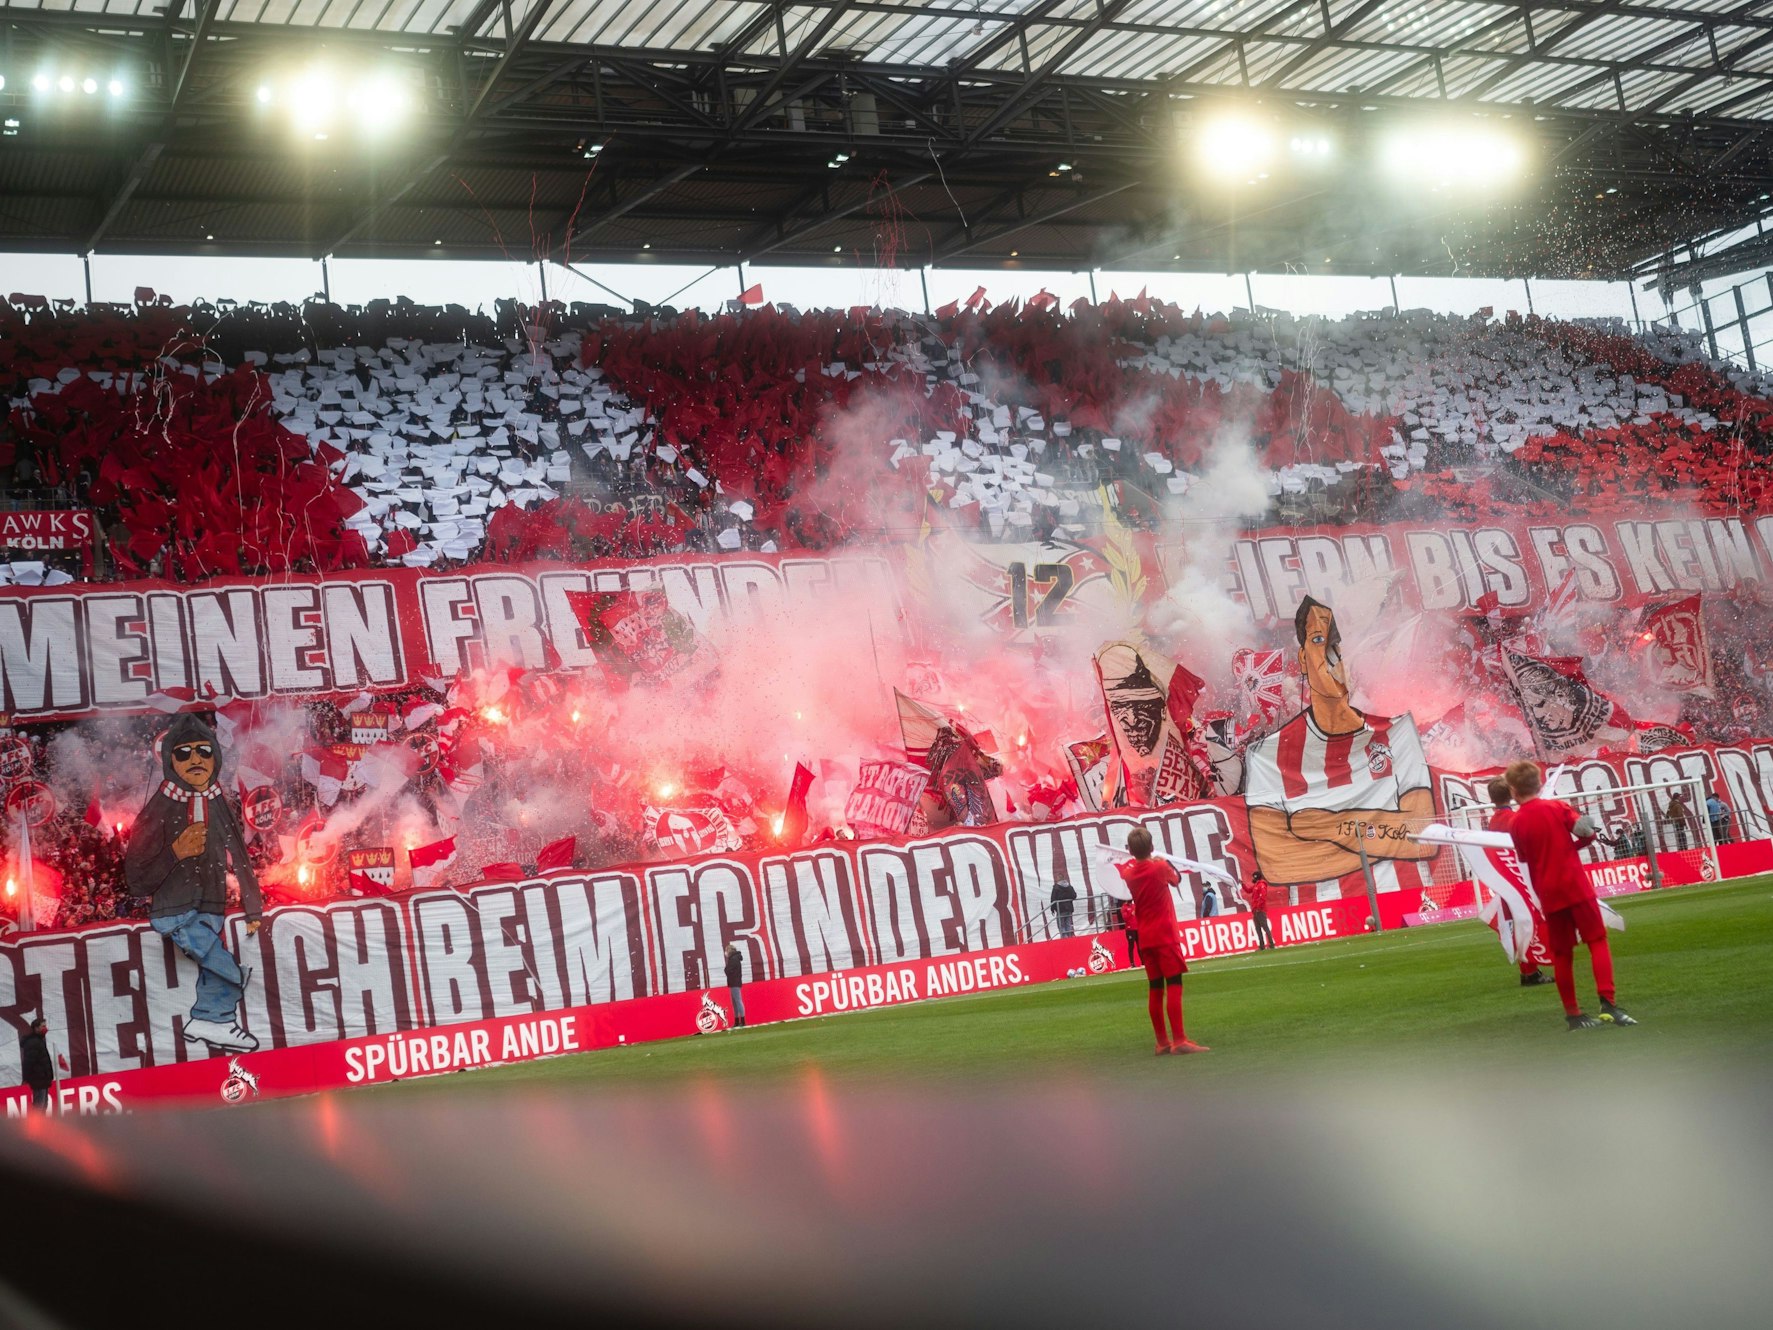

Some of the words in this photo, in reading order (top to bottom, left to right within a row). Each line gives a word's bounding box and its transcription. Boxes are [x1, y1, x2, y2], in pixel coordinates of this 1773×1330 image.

[7, 534, 64, 550] KÖLN
[1406, 527, 1531, 612] BIS
[1530, 523, 1622, 603] ES
[1614, 515, 1767, 598] KEIN
[0, 581, 407, 714] MEINEN
[417, 558, 910, 678] FRENDE
[1007, 562, 1074, 629] 12
[1625, 753, 1718, 853] IST
[226, 899, 402, 1053] ICH
[410, 873, 650, 1029] BEIM
[646, 859, 770, 996] FC
[761, 849, 872, 979] IN
[858, 827, 1022, 964] DER
[796, 969, 919, 1016] SPÜRBAR
[926, 953, 1030, 997] ANDERS.
[345, 1034, 492, 1083] SPÜRBAR
